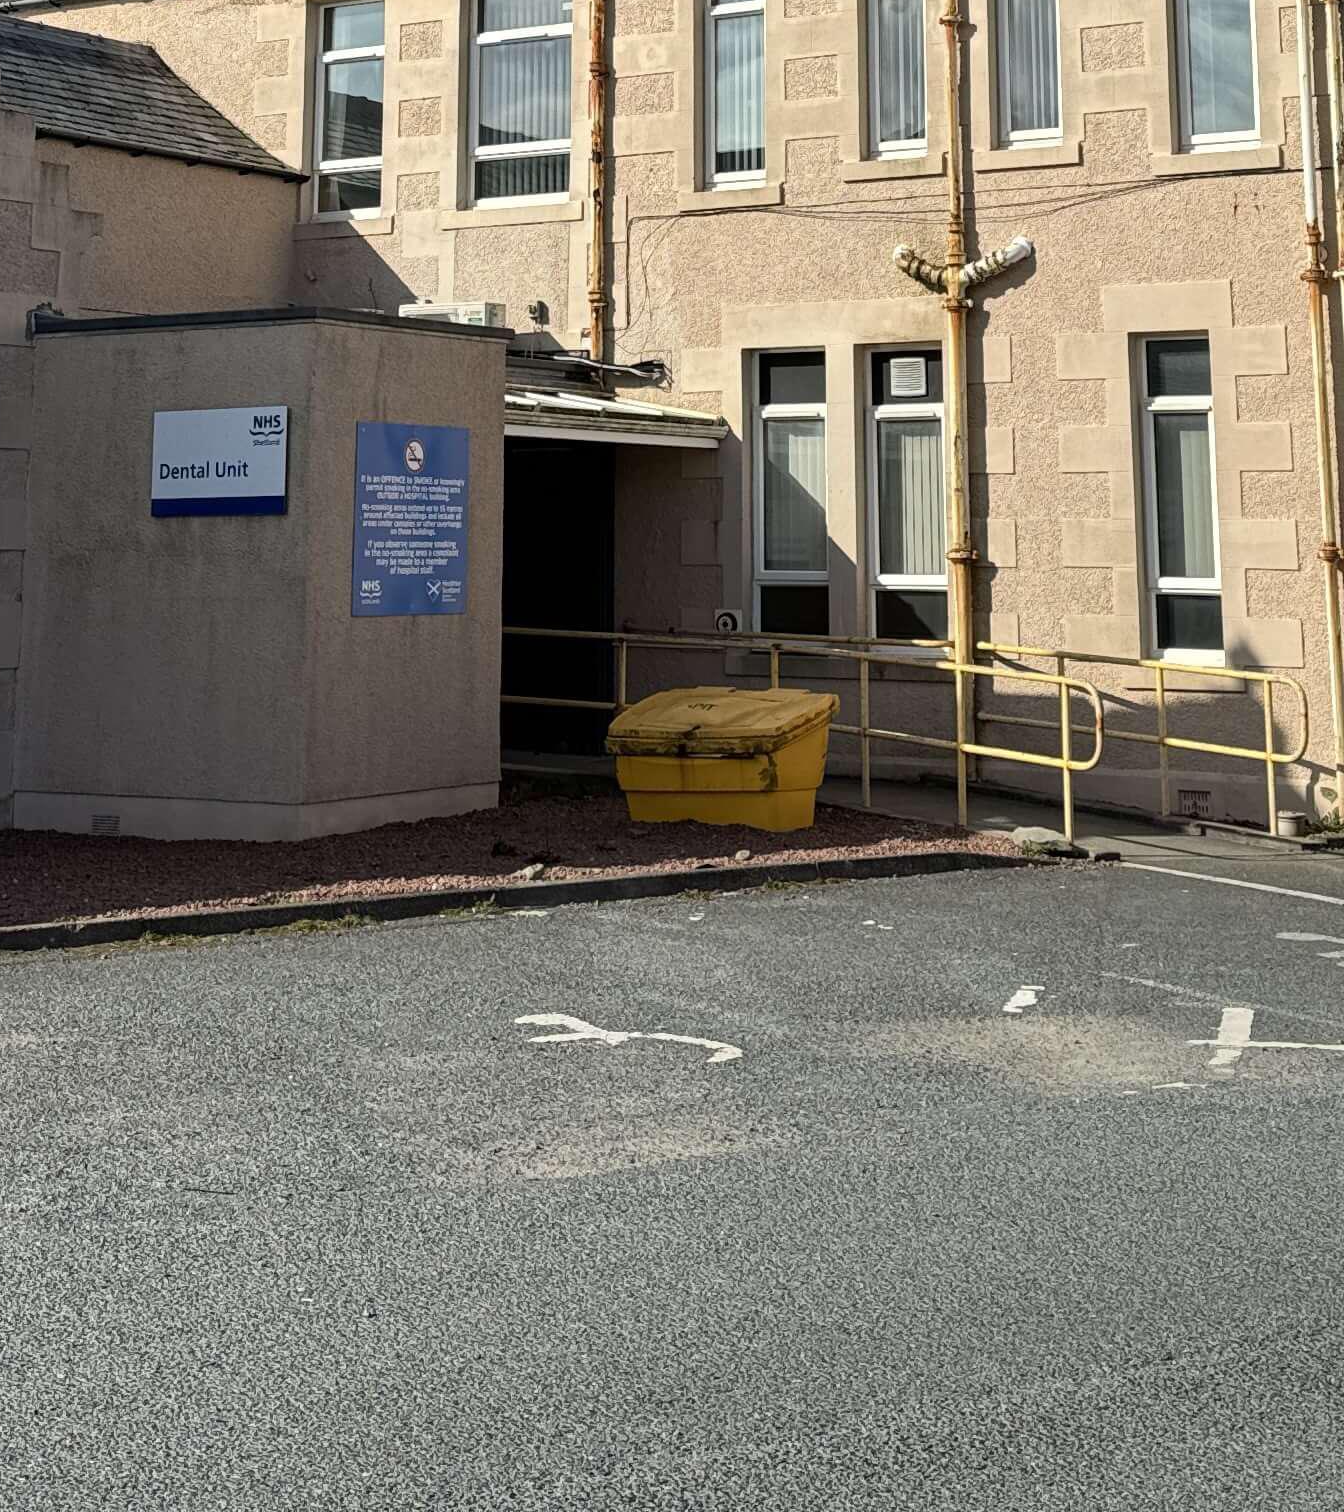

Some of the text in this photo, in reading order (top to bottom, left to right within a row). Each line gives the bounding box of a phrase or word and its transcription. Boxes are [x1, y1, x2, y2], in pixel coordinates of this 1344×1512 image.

[253, 415, 281, 429] NHS
[160, 460, 248, 479] Dental Unit
[362, 580, 380, 591] NHS
